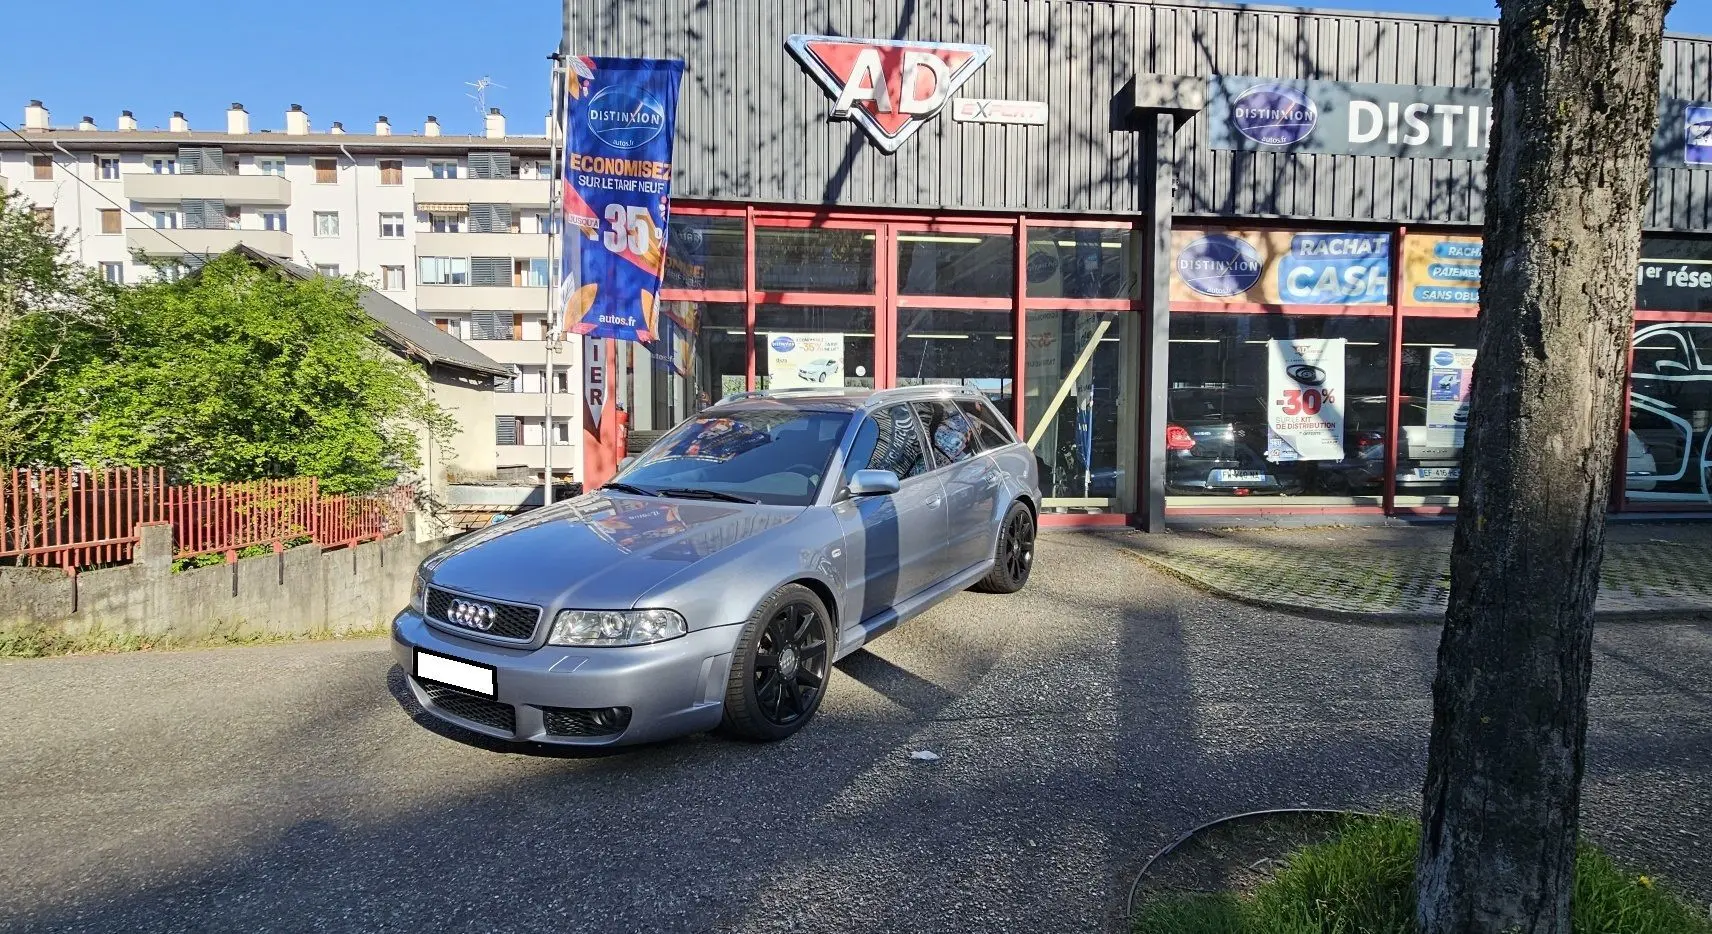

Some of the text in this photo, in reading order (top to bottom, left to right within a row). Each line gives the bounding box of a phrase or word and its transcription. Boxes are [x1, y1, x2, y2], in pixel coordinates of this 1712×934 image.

[829, 48, 950, 117] AD
[590, 109, 660, 125] DISTINXION
[1235, 107, 1313, 121] DISTINXION
[1348, 100, 1493, 148] DISTI
[1261, 135, 1287, 143] autos.fr
[570, 153, 671, 180] ECONOMISEZ
[578, 175, 664, 194] SUR LE TARIF NEUF
[1300, 238, 1387, 256] RACHAT
[1180, 259, 1258, 272] DISTINXION
[1286, 265, 1388, 297] CASH
[1422, 290, 1452, 300] SANS
[599, 314, 636, 327] autos.fr
[590, 337, 603, 406] IER
[1276, 388, 1336, 415] -30%
[1287, 422, 1336, 430] DISTRIBUTION
